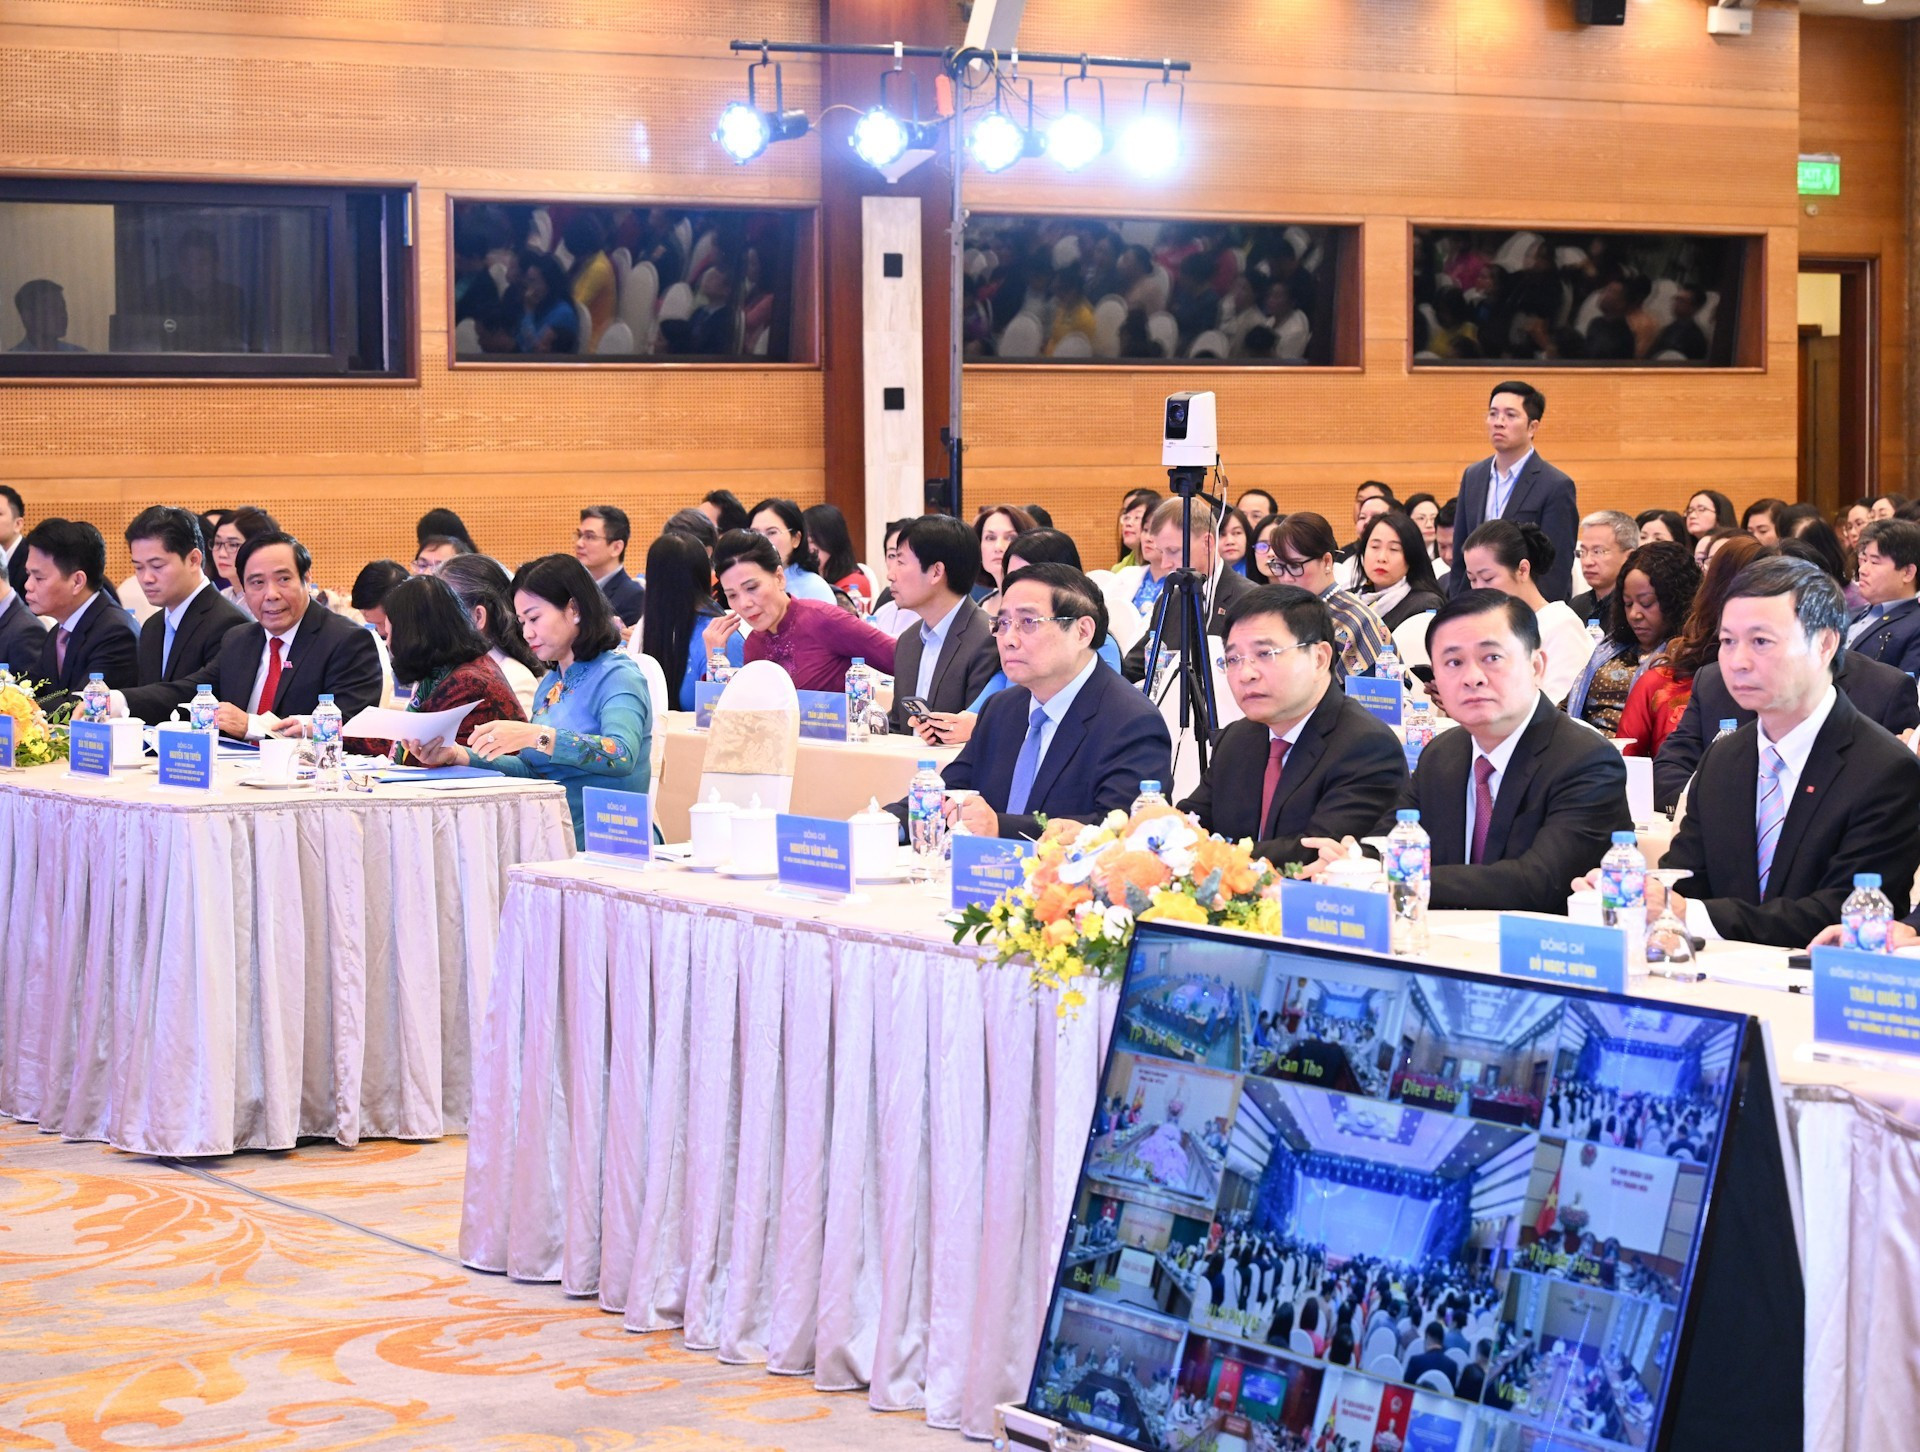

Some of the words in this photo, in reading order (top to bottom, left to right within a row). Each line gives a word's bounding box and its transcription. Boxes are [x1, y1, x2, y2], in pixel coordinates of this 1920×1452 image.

[1315, 900, 1340, 915] ĐỒNG
[1340, 904, 1355, 917] CHÍ
[1540, 937, 1568, 954] ĐỒNG
[1568, 942, 1585, 955] CHÍ
[1277, 1054, 1300, 1074] Can
[1302, 1058, 1325, 1079] Tho
[1401, 1078, 1431, 1099] Dien
[1073, 1266, 1093, 1286] Bac
